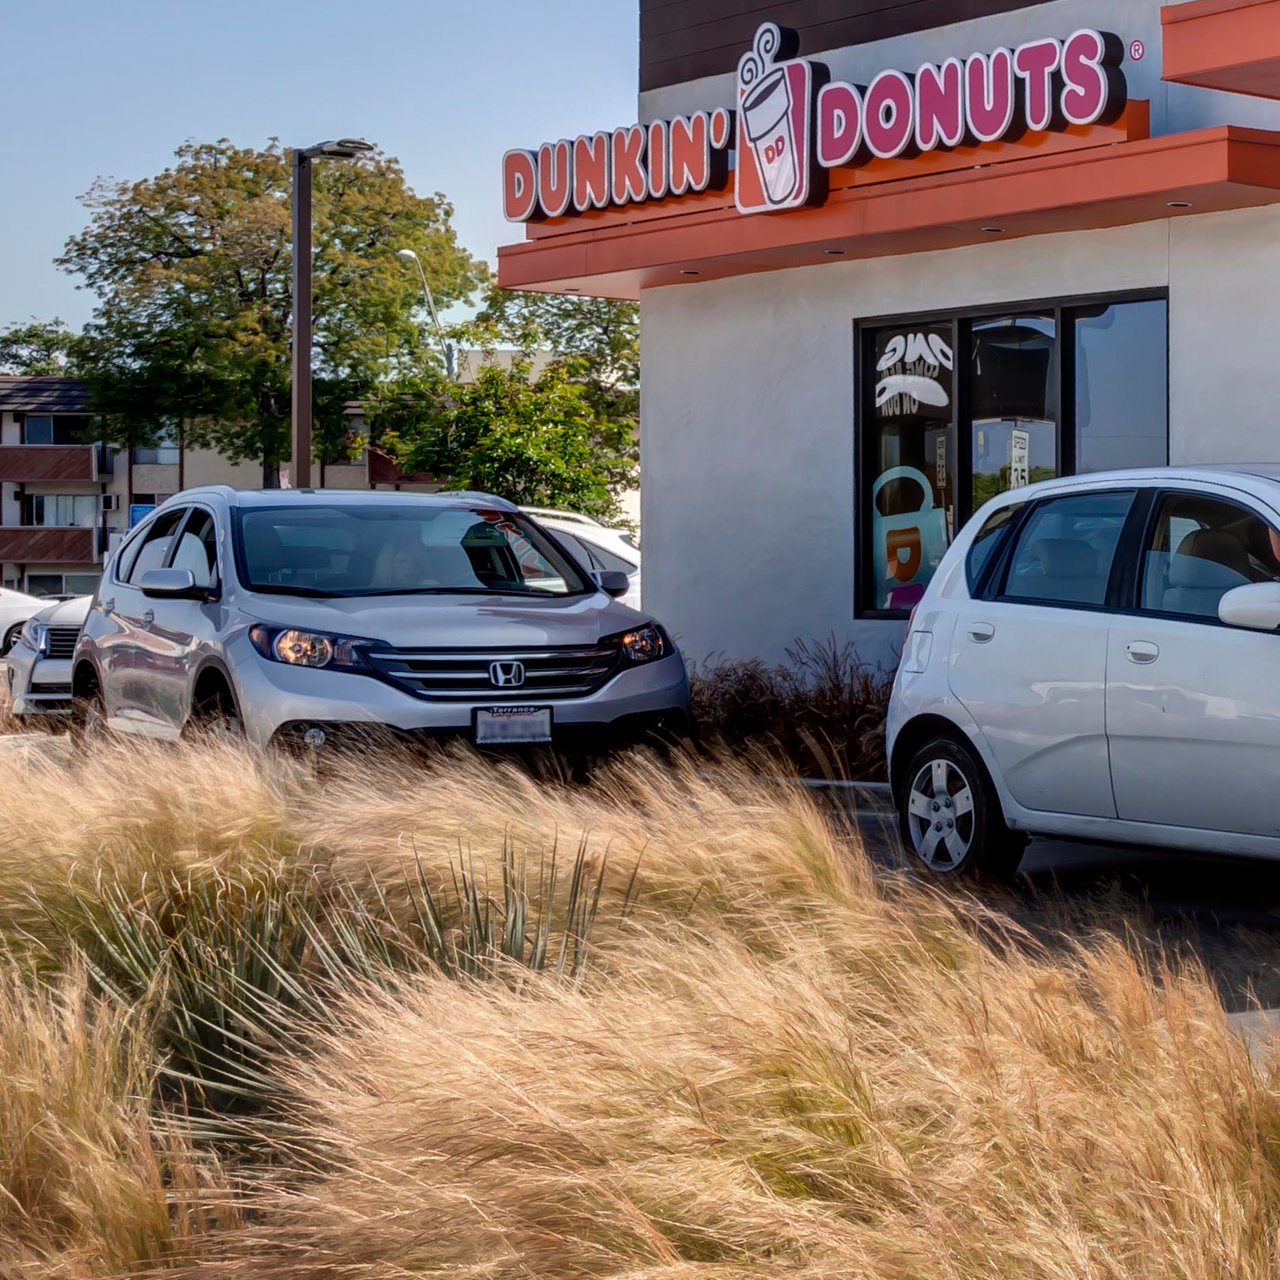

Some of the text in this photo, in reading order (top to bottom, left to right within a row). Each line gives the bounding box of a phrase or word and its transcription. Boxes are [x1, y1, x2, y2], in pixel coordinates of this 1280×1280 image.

[502, 107, 729, 222] DUNKIN'
[817, 28, 1107, 168] DONUTS
[763, 134, 786, 165] DD
